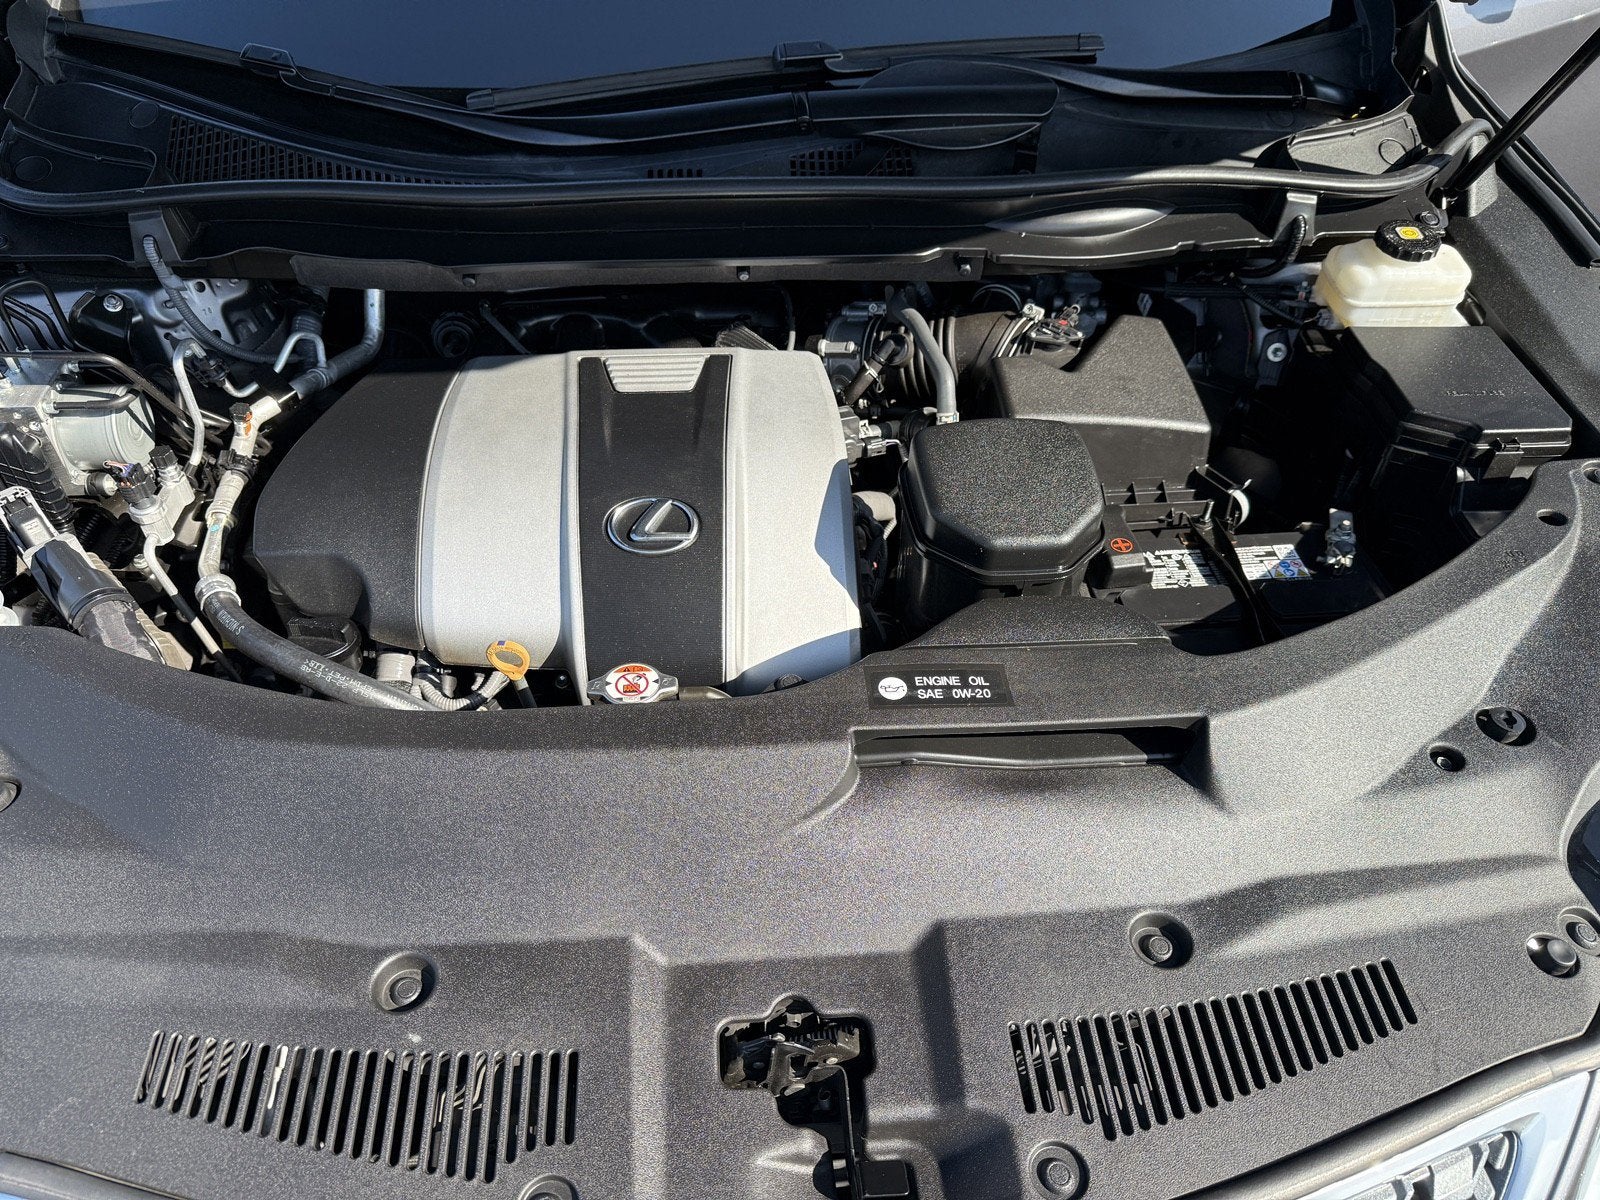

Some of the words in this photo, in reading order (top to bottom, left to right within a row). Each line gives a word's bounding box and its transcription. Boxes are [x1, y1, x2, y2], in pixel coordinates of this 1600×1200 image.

[914, 676, 961, 687] ENGINE
[968, 676, 989, 686] OIL
[917, 688, 944, 699] SAE
[952, 688, 991, 699] 0W-20
